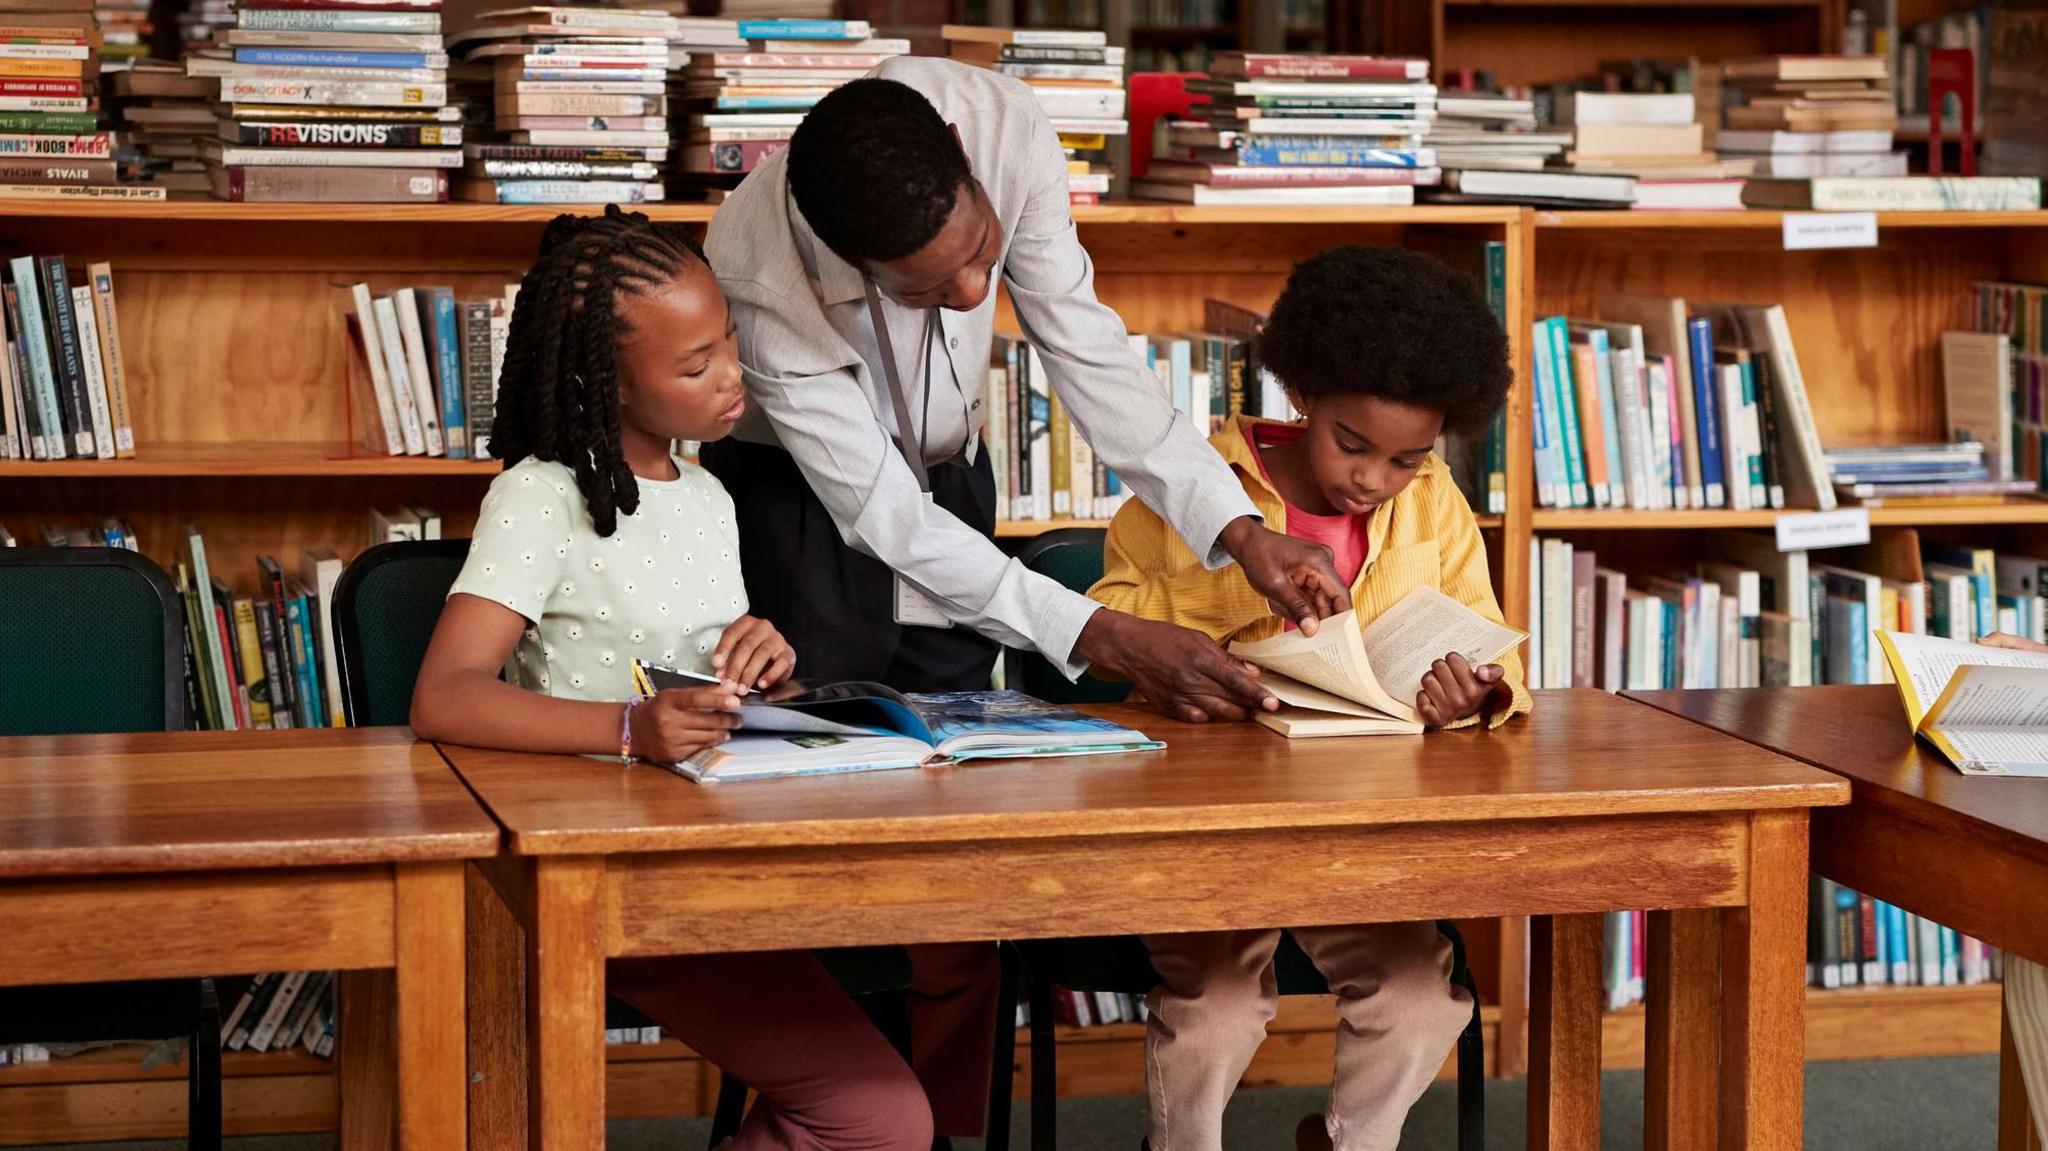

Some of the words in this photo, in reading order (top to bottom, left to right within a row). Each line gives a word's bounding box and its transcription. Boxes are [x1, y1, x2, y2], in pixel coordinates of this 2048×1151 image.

[270, 125, 388, 144] REVISIONS
[35, 140, 65, 153] BOOK
[47, 167, 88, 178] RIVALS
[50, 262, 63, 281] THE
[53, 281, 68, 313] PRIVATE
[59, 313, 71, 332] LIFE
[62, 332, 73, 344] OF
[63, 344, 79, 376] PLANTS
